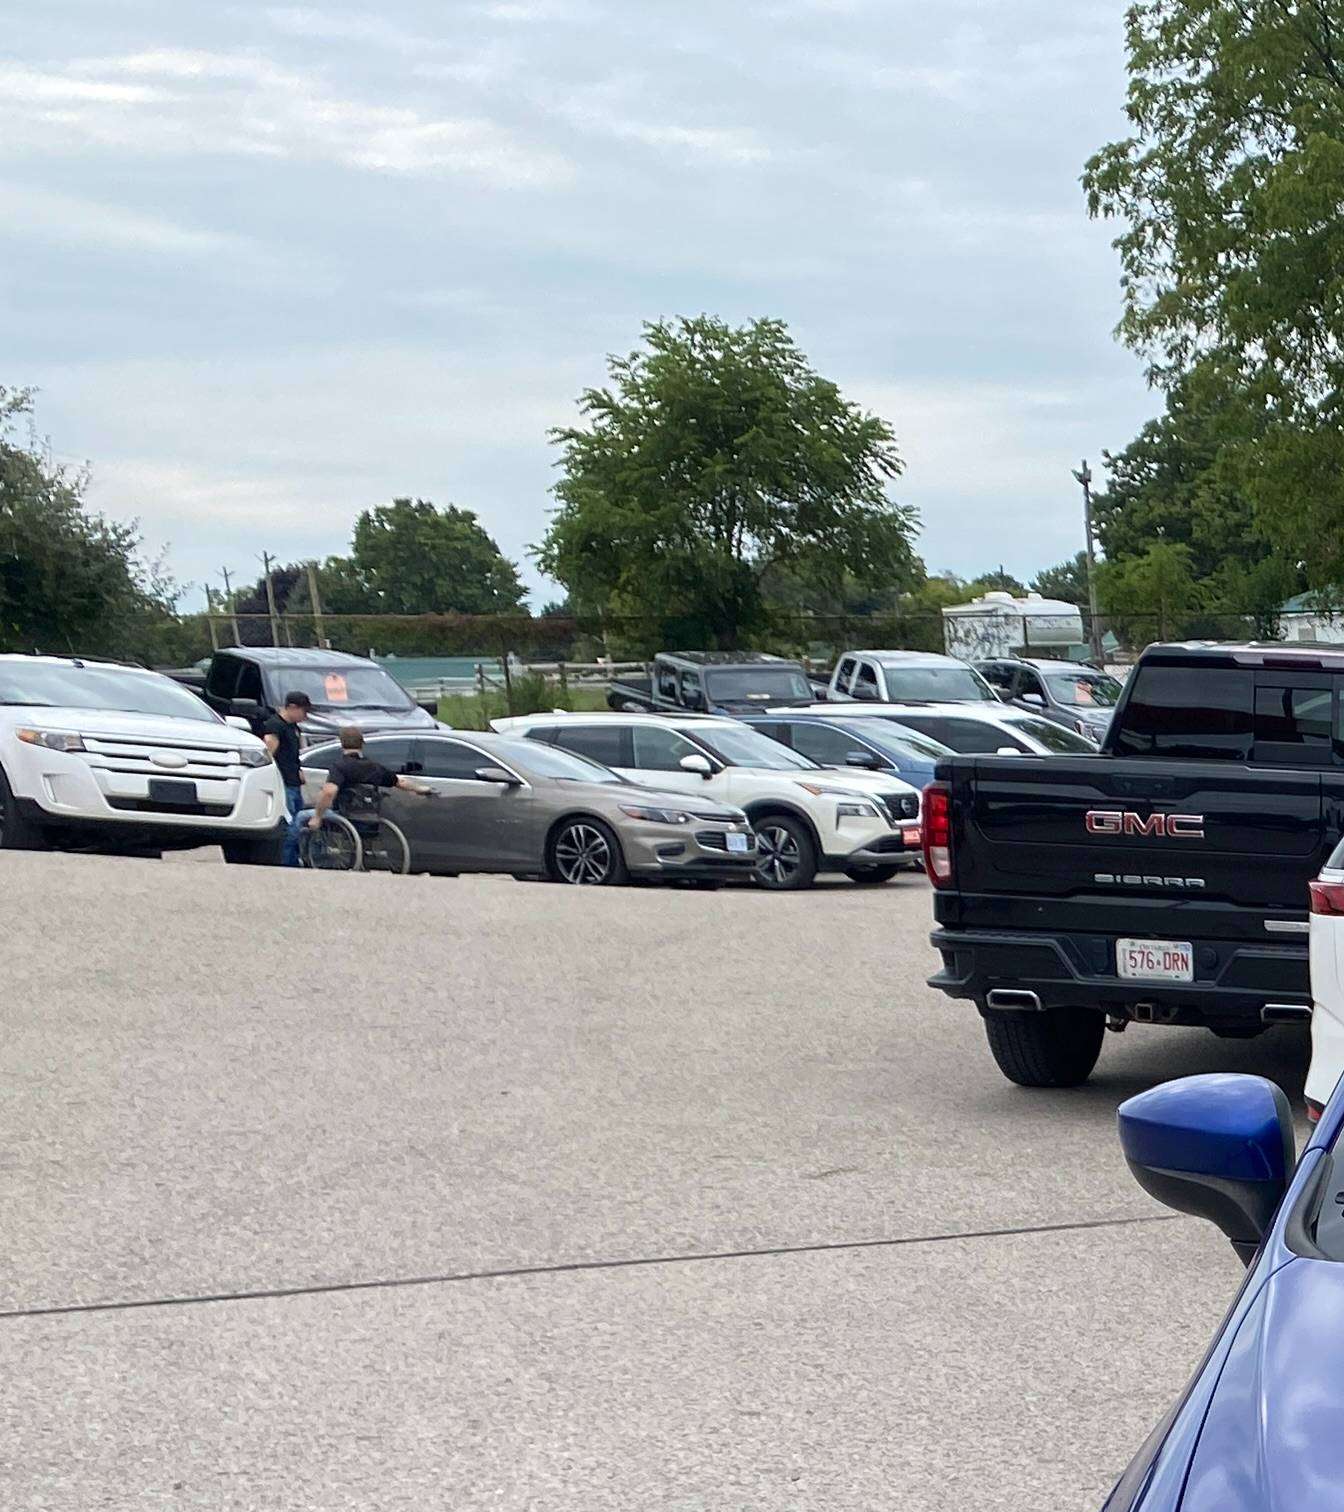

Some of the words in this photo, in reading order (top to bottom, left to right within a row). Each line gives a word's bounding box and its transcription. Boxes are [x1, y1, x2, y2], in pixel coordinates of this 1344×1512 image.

[1085, 810, 1205, 839] GMC
[1094, 873, 1205, 888] SIERRA
[1129, 950, 1155, 970] 576
[1163, 952, 1189, 971] DRN
